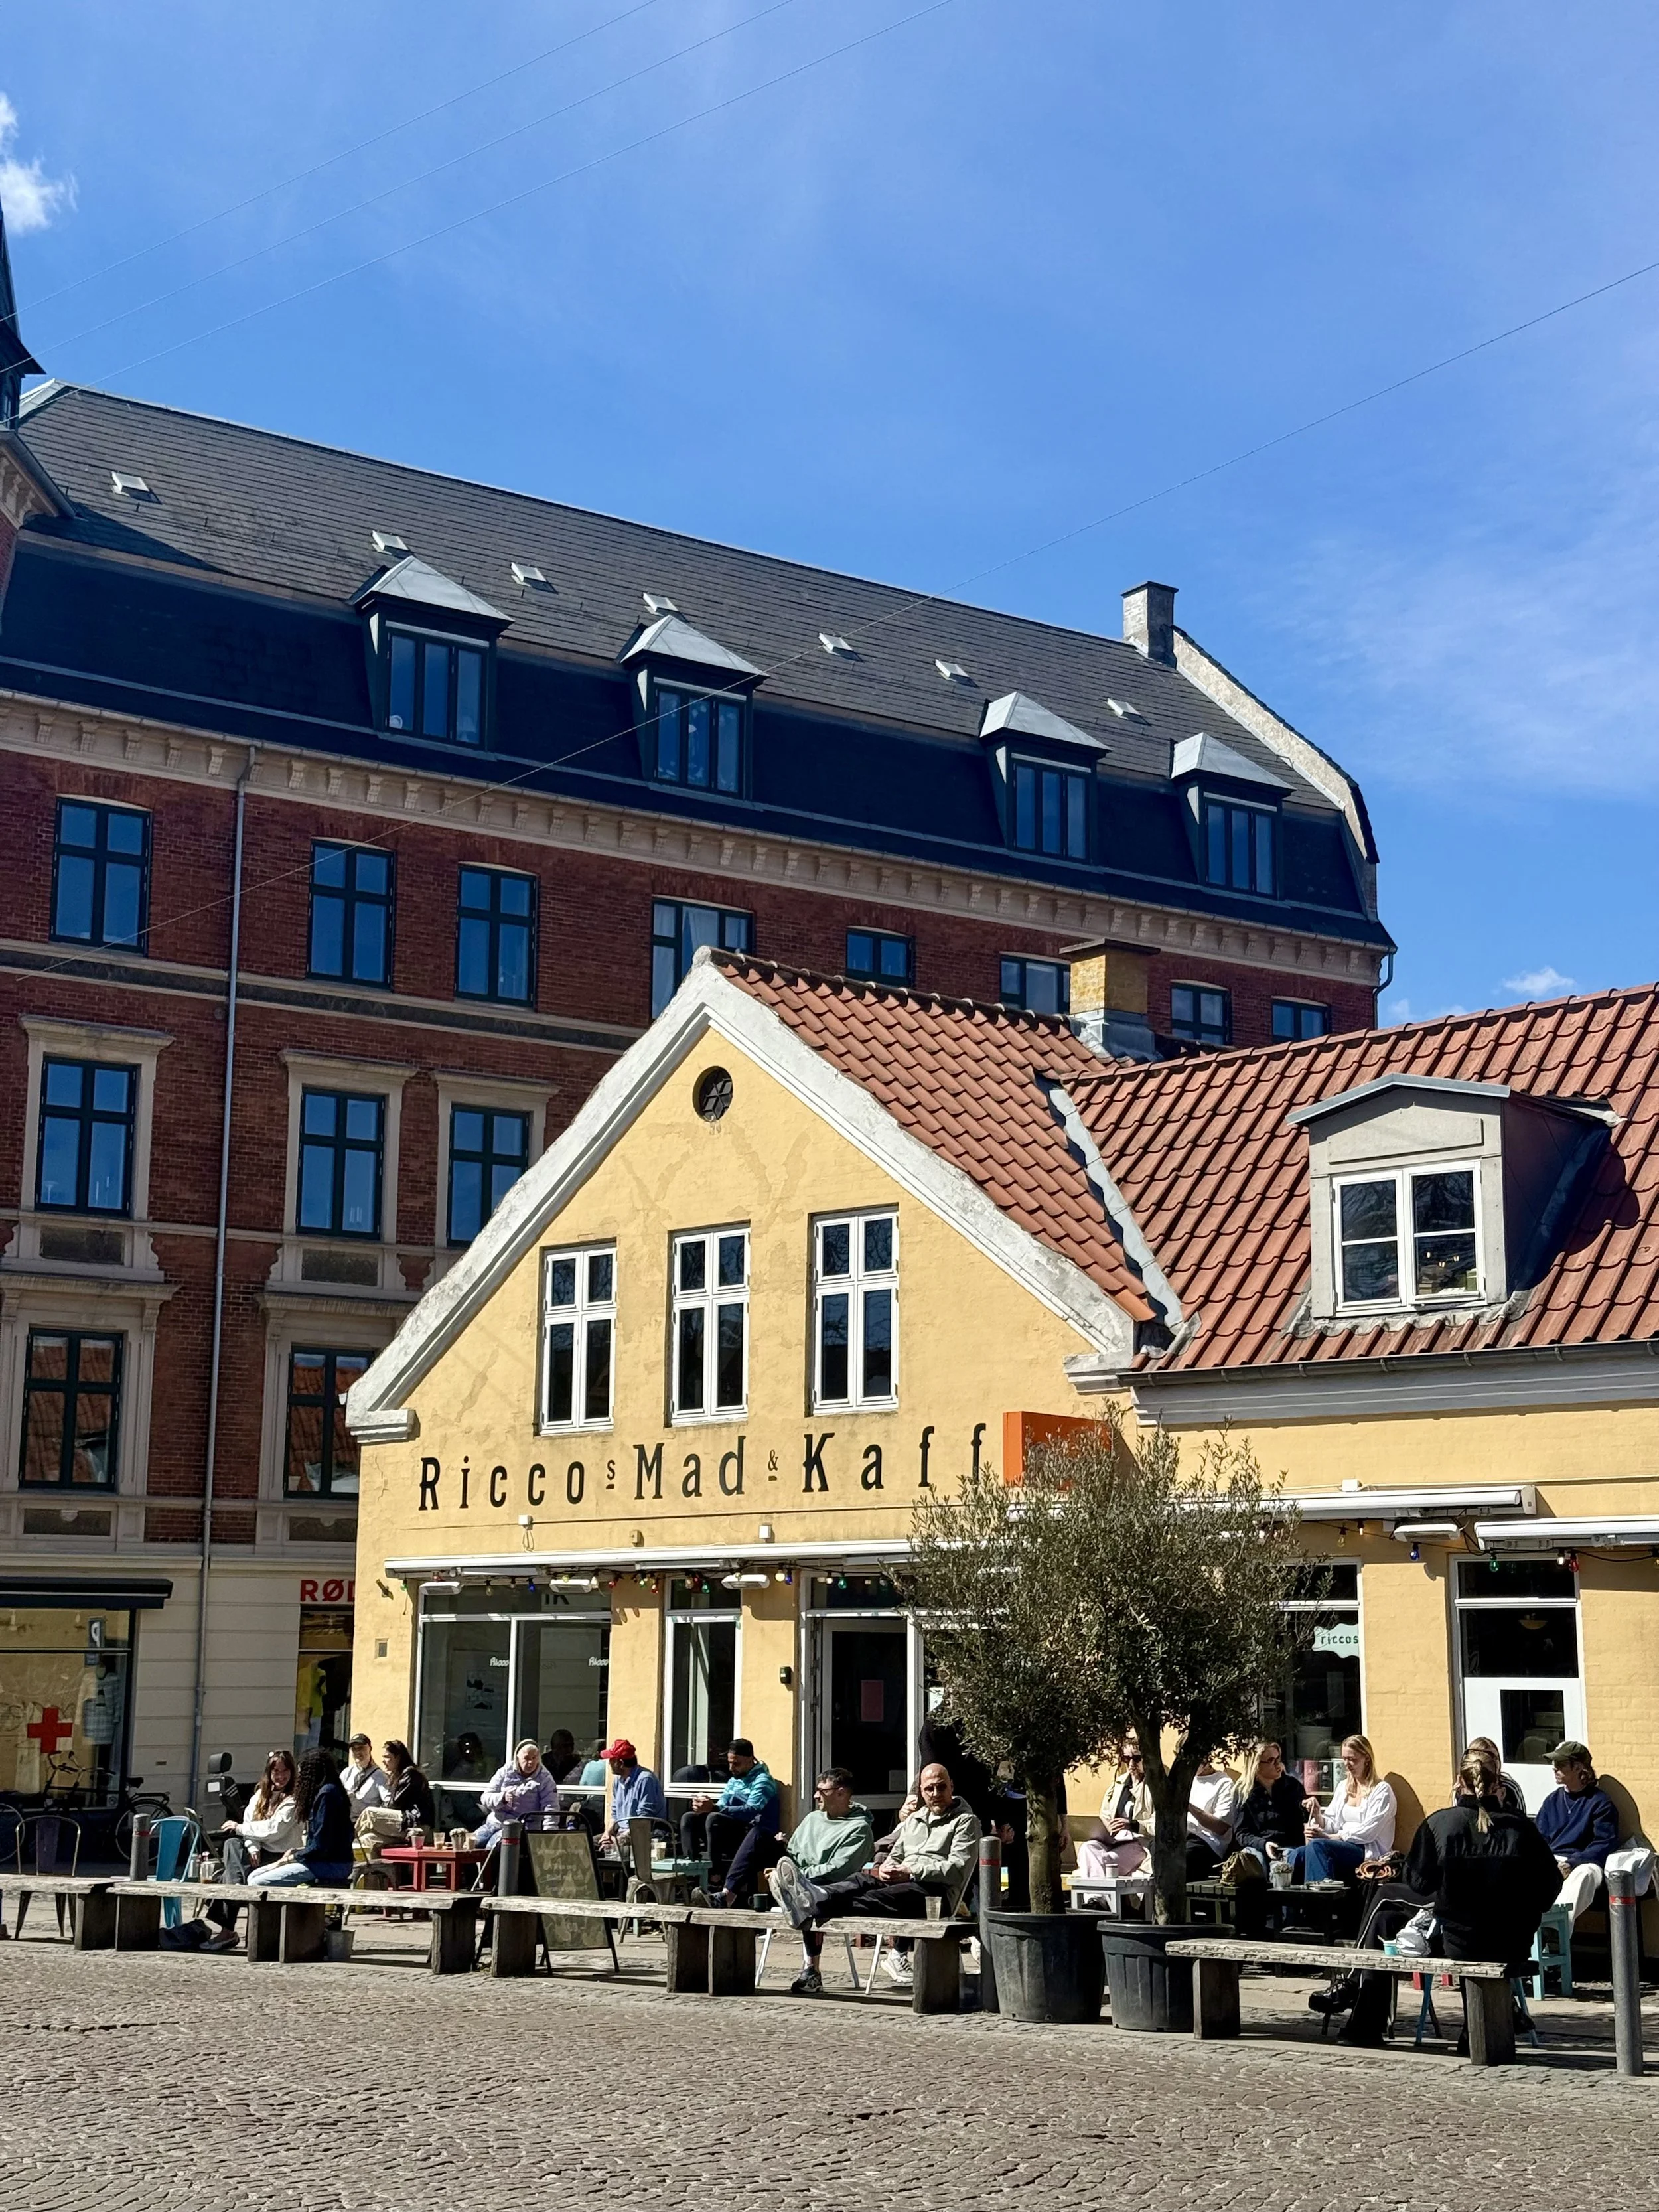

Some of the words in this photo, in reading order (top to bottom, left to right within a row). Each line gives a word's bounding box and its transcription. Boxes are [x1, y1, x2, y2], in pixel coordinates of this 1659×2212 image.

[633, 1436, 746, 1500] Mad
[768, 1449, 778, 1473] &
[1321, 1633, 1359, 1645] riccos
